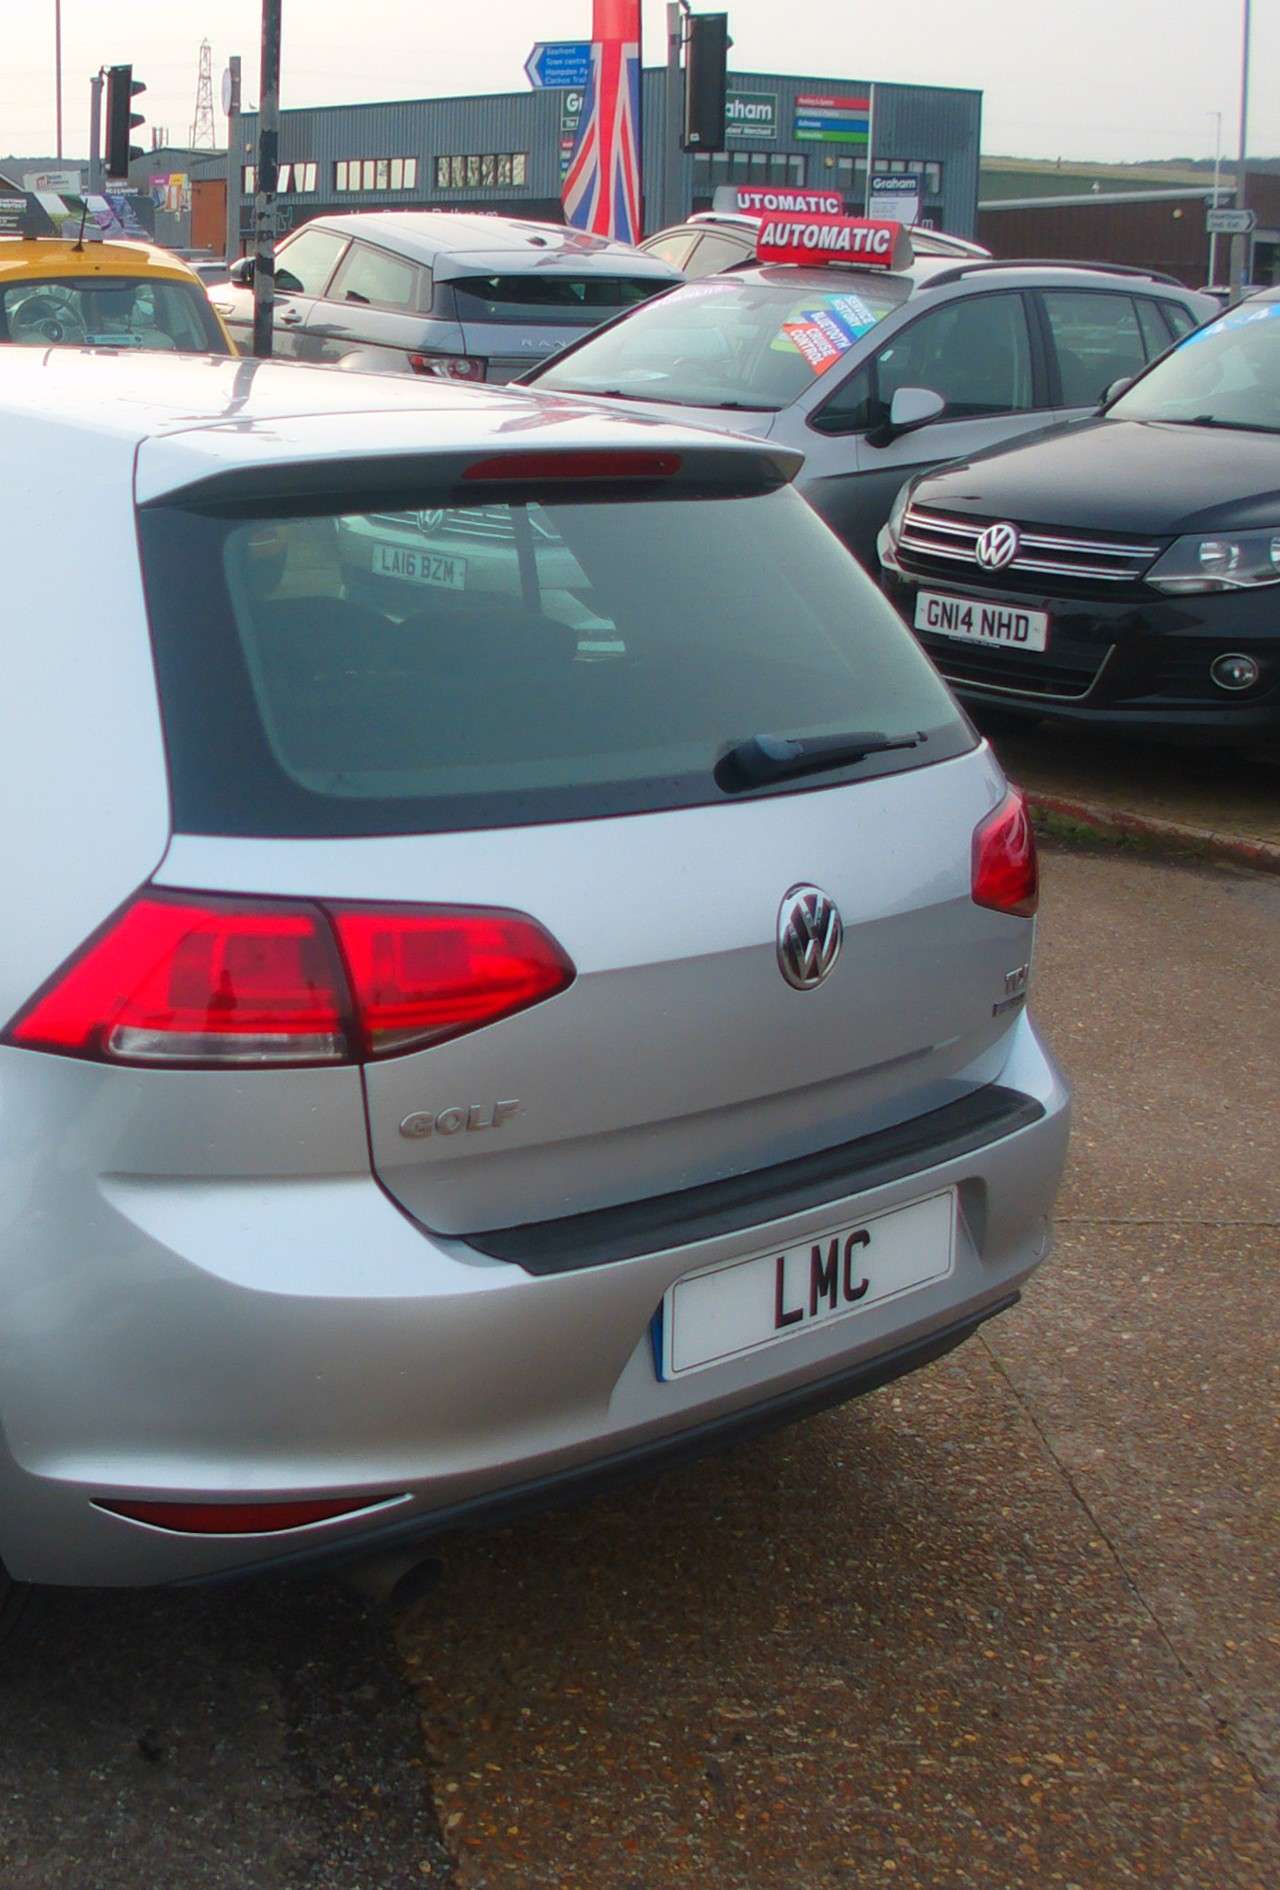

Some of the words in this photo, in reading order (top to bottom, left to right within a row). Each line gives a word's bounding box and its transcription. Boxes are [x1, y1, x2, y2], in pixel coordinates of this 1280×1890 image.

[725, 99, 772, 120] aham
[873, 177, 916, 189] Graham
[737, 193, 839, 213] UTOMATIC
[760, 223, 891, 253] AUTOMATIC
[810, 311, 853, 349] BLUETOOTH
[381, 546, 417, 577] LA16
[420, 556, 455, 584] BZM
[927, 599, 973, 633] GN14
[980, 608, 1030, 642] NHD
[399, 1098, 520, 1139] GOLF
[775, 1229, 871, 1330] LMC
